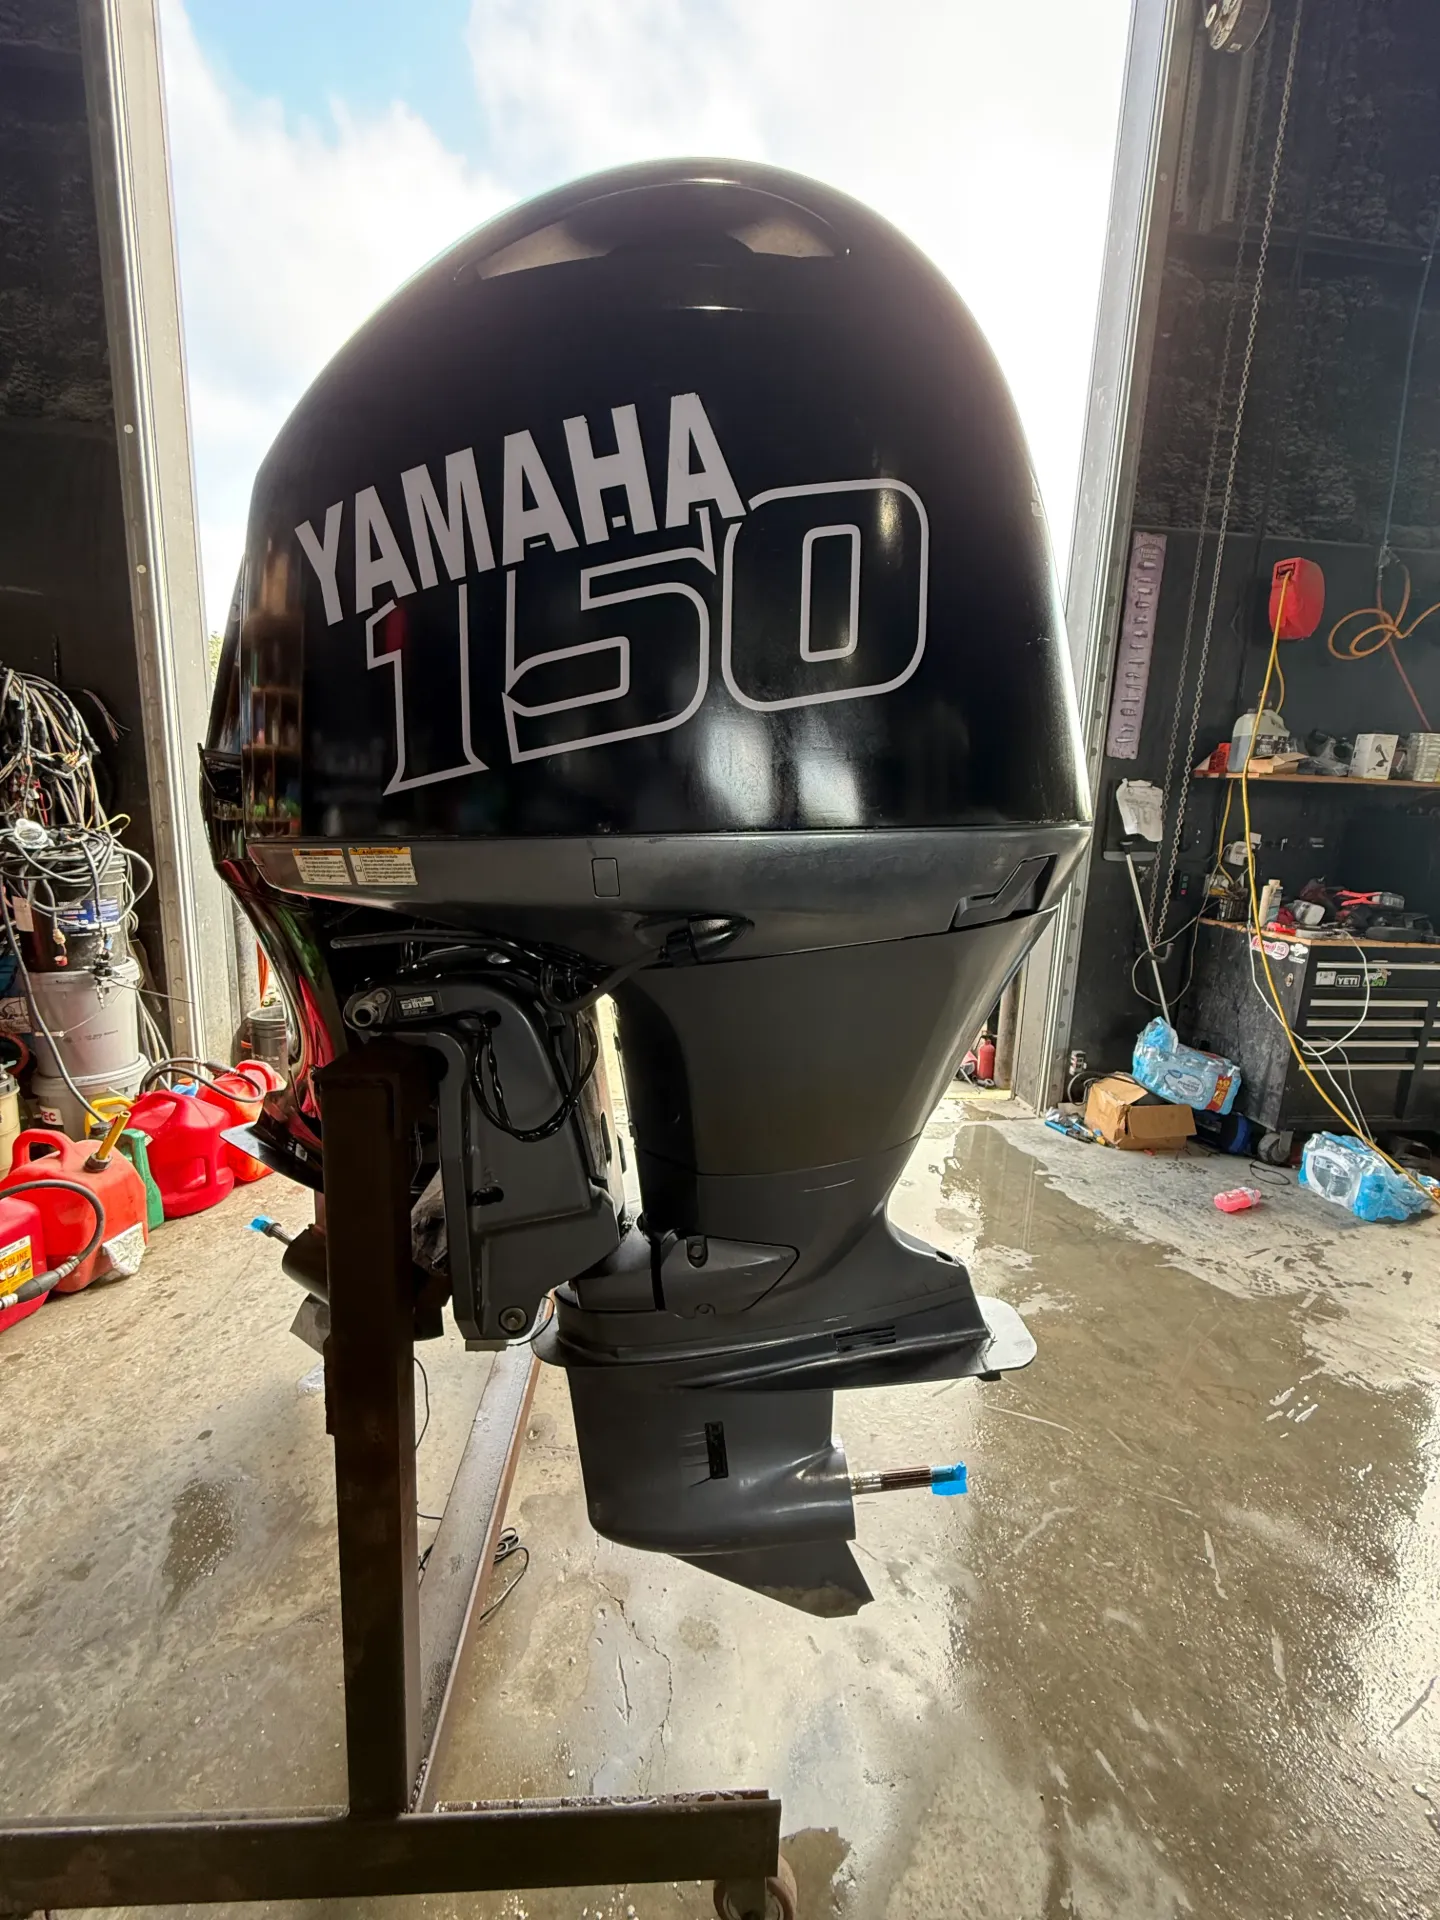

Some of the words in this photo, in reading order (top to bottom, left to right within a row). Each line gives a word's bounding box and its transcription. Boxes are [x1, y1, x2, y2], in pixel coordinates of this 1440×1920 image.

[294, 392, 747, 626] YAMAHA
[366, 477, 930, 797] 150
[1337, 976, 1358, 986] YETI
